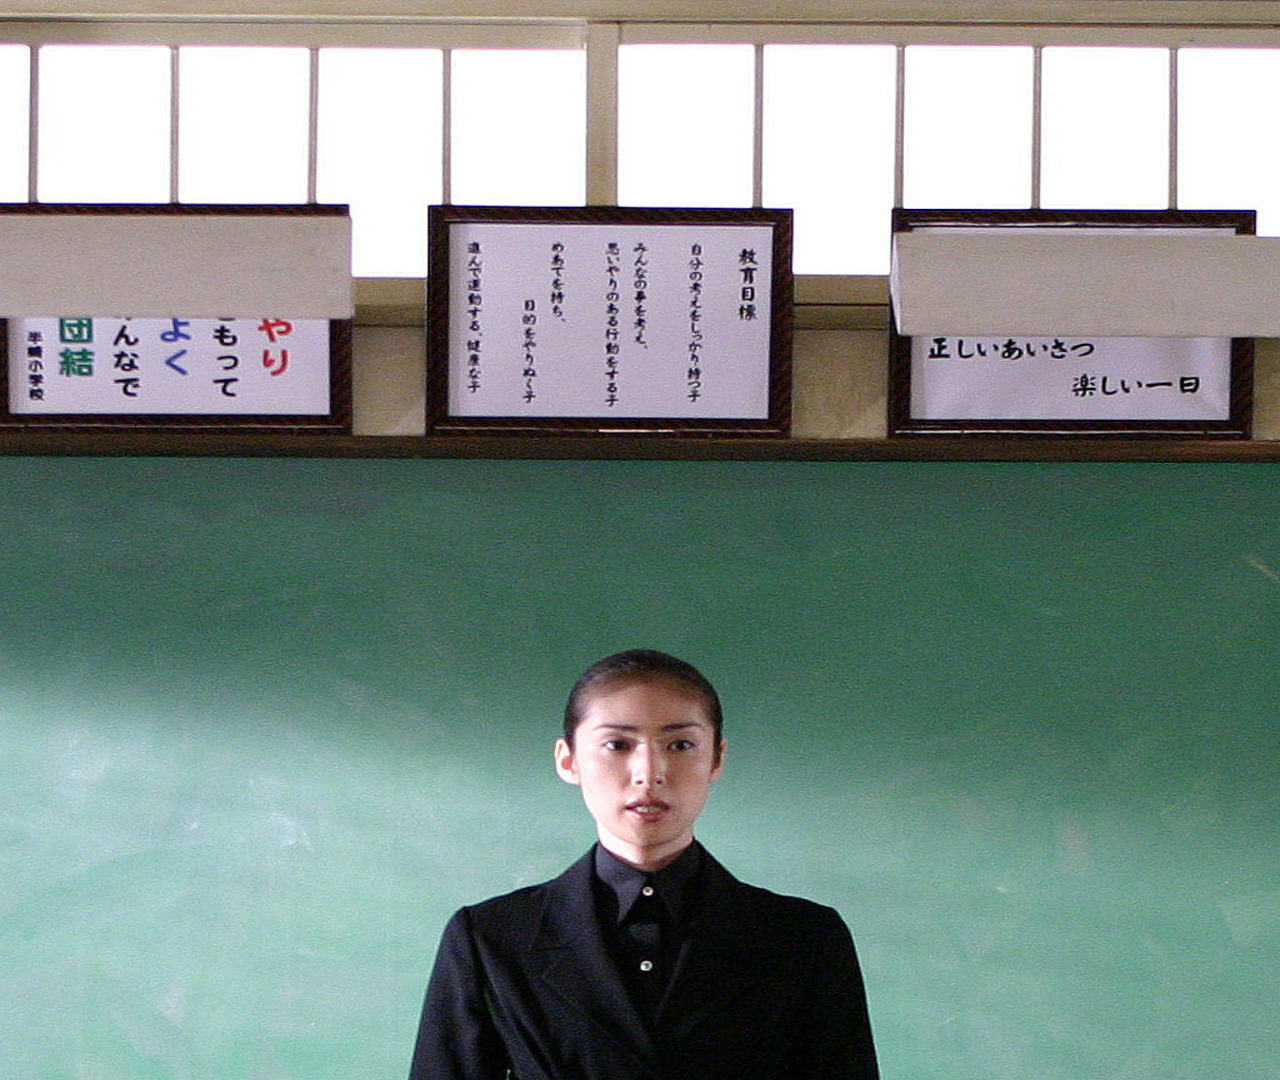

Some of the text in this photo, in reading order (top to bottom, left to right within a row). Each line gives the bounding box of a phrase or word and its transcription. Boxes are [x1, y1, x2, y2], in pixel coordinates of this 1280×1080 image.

[739, 248, 757, 321] 教育目標
[59, 318, 94, 377] 団結
[113, 318, 140, 397] んなで
[213, 318, 239, 397] もって
[605, 243, 620, 407] 思いやりのある行動をする子
[928, 337, 1095, 361] 正しいあいさつ
[1072, 373, 1200, 397] 楽しい一日
